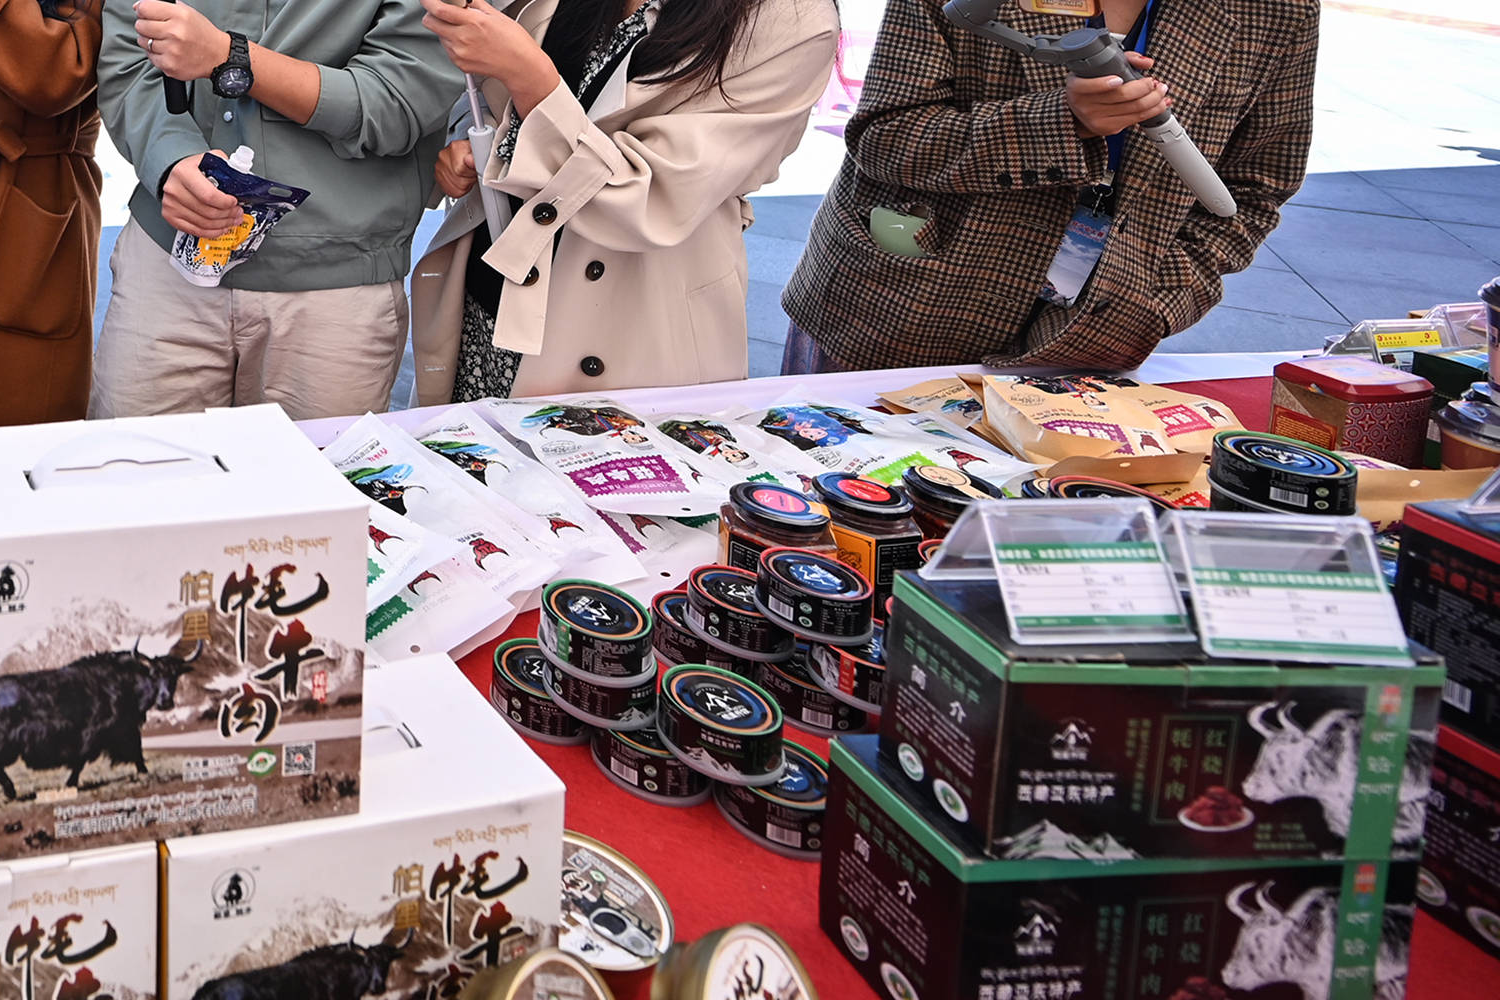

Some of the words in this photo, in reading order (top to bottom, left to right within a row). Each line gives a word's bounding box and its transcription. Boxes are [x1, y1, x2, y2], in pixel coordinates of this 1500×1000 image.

[180, 570, 213, 641] 帕里
[220, 563, 329, 743] 牦牛肉
[393, 863, 424, 931] 帕里
